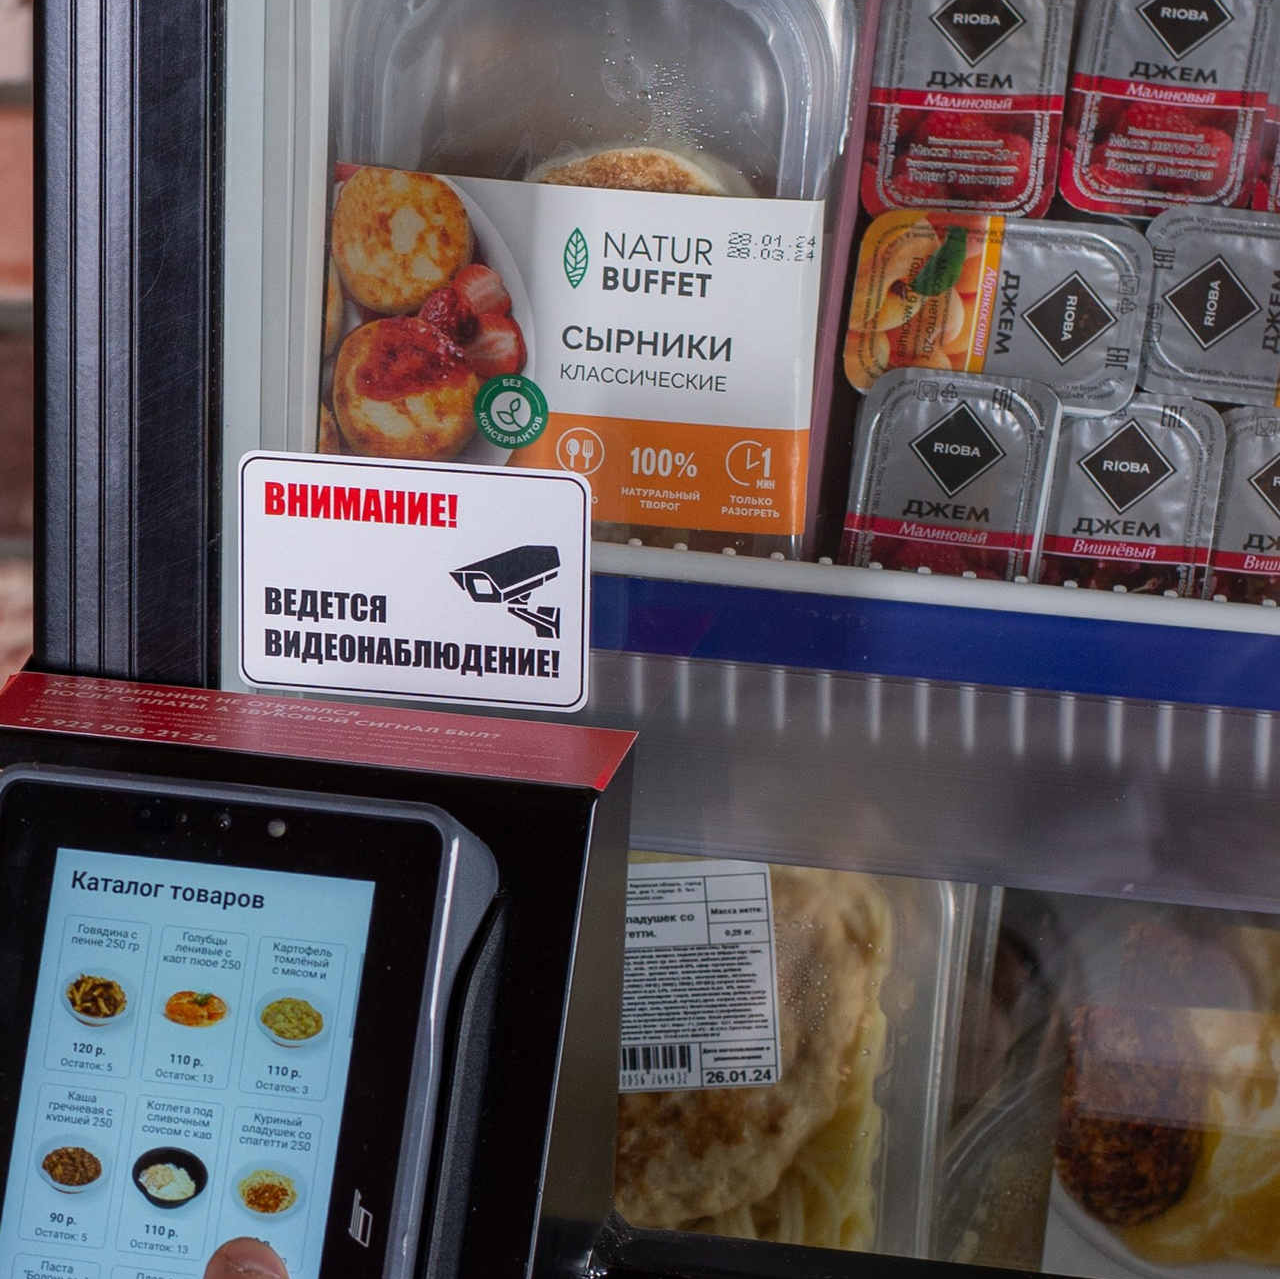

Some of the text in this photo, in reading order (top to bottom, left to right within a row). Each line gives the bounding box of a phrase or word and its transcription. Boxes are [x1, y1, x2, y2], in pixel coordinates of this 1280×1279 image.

[953, 13, 1001, 25] RIOBA
[1160, 6, 1209, 22] RIOBA
[926, 71, 1013, 89] ДЖЕМ
[1129, 61, 1218, 84] ДЖЕМ
[924, 92, 1013, 110] Малиновый
[1126, 82, 1216, 104] Малиновый
[603, 231, 713, 266] NATUR
[602, 266, 713, 297] BUFFET
[973, 266, 998, 356] Абрикосовый
[1204, 280, 1221, 327] RIOBA
[993, 270, 1020, 355] ДЖЕМ
[1061, 295, 1078, 342] RIOBA
[561, 325, 732, 362] СЫРНИКИ
[502, 378, 522, 389] БЕЗ
[560, 363, 727, 392] КЛАССИЧЕСКИЕ
[478, 412, 544, 445] КОНСЕРВАНТОВ
[933, 442, 981, 458] RIOBA
[630, 446, 698, 478] 100%
[1103, 460, 1150, 474] RIOBA
[756, 479, 775, 490] МИН
[621, 486, 700, 501] НАТУРАЛЬНЫЙ
[730, 495, 773, 506] ТОЛЬКО
[264, 481, 459, 528] ВНИМАНИЕ!
[639, 499, 680, 511] ТВОРОГ
[721, 506, 780, 519] РАЗОГРЕТЬ
[902, 499, 990, 523] ДЖЕМ
[898, 522, 988, 544] Малиновый
[1072, 517, 1161, 539] ДЖЕМ
[1072, 539, 1157, 560] Вишнёвый
[264, 586, 387, 623] ВЕДЕТСЯ
[264, 628, 560, 678] ВИДЕОНАБЛЮДЕНИЕ!
[51, 680, 361, 717] ХОЛОДИЛЬНИК НЕ ОТКРЫЛСЯ
[43, 688, 114, 701] ПОСЛЕ
[118, 695, 209, 710] ОПЛАТЫ,
[235, 706, 348, 724] ЗВУКОВОЙ
[354, 719, 438, 734] СИГНАЛ
[445, 728, 501, 740] БЫЛ?
[19, 716, 219, 742] +7 922 908-21-25
[71, 870, 265, 910] Каталог товаров
[679, 913, 695, 922] со
[710, 908, 737, 916] Масса
[78, 924, 138, 939] Говядина с
[182, 932, 228, 947] Голубцы
[71, 936, 140, 953] пенне 250 гр
[175, 944, 232, 958] ленивые с
[273, 941, 333, 958] Картофель
[221, 959, 241, 971] 250
[274, 954, 330, 969] томлёный
[272, 967, 327, 980] с мясом и
[72, 1042, 106, 1057] 120 р.
[60, 1057, 105, 1072] Остаток:
[169, 1053, 204, 1069] 110 р.
[155, 1069, 214, 1084] Остаток: 13
[267, 1065, 302, 1080] 110 р.
[706, 1068, 772, 1084] 26.01.24
[255, 1080, 300, 1095] Остаток:
[67, 1091, 97, 1104] Каша
[48, 1101, 114, 1117] гречневая с
[146, 1100, 213, 1119] Котлета под
[92, 1116, 113, 1128] 250
[146, 1112, 210, 1128] сливочным
[253, 1112, 303, 1128] Куриный
[241, 1124, 312, 1140] оладушек со
[239, 1135, 312, 1152] спагетти 250
[49, 1212, 77, 1227] 90 р.
[34, 1227, 80, 1241] Остаток:
[144, 1224, 179, 1239] 110 р.
[130, 1239, 189, 1255] Остаток: 13
[40, 1260, 74, 1274] Паста
